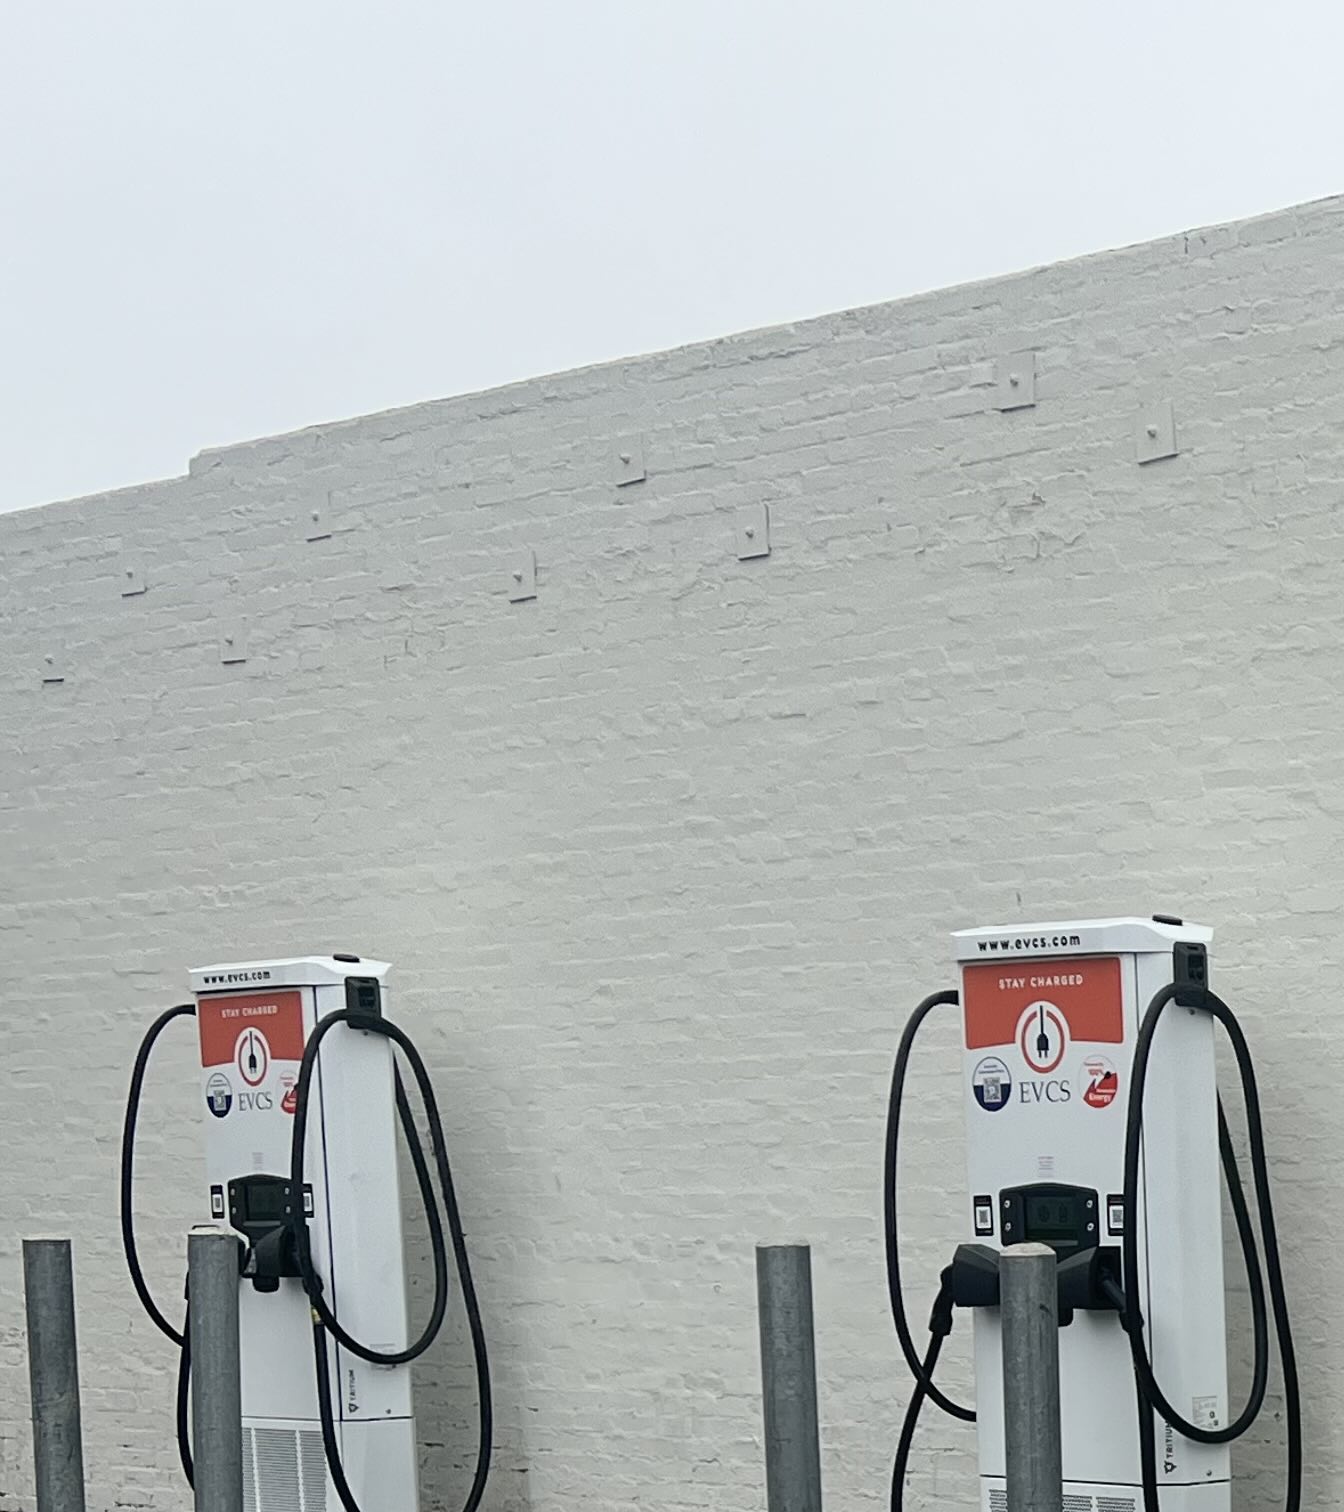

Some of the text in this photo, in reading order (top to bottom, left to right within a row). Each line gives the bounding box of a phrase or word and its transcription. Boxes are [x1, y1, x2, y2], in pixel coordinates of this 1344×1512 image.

[977, 934, 1080, 951] www.evcs.com
[203, 971, 271, 984] www.evcs.com
[999, 974, 1084, 990] STAY CHARGED
[221, 1008, 240, 1018] STAY
[1018, 1080, 1072, 1104] EVCS
[238, 1091, 273, 1112] EVCS
